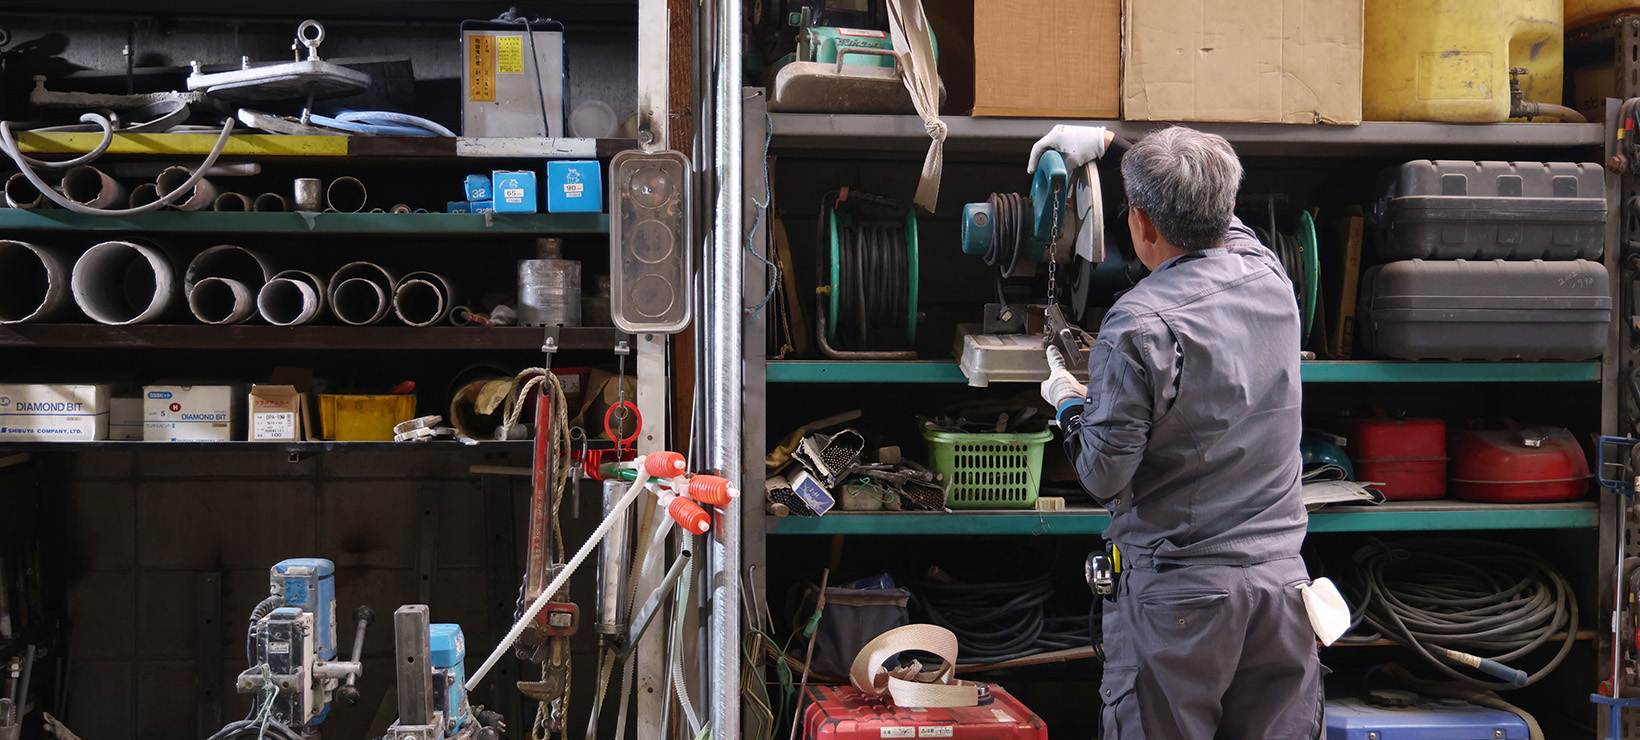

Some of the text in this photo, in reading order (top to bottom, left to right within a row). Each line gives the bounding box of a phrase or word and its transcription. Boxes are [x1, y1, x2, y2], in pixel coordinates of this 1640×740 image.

[472, 188, 486, 198] 32
[16, 402, 82, 411] DIAMOND BIT
